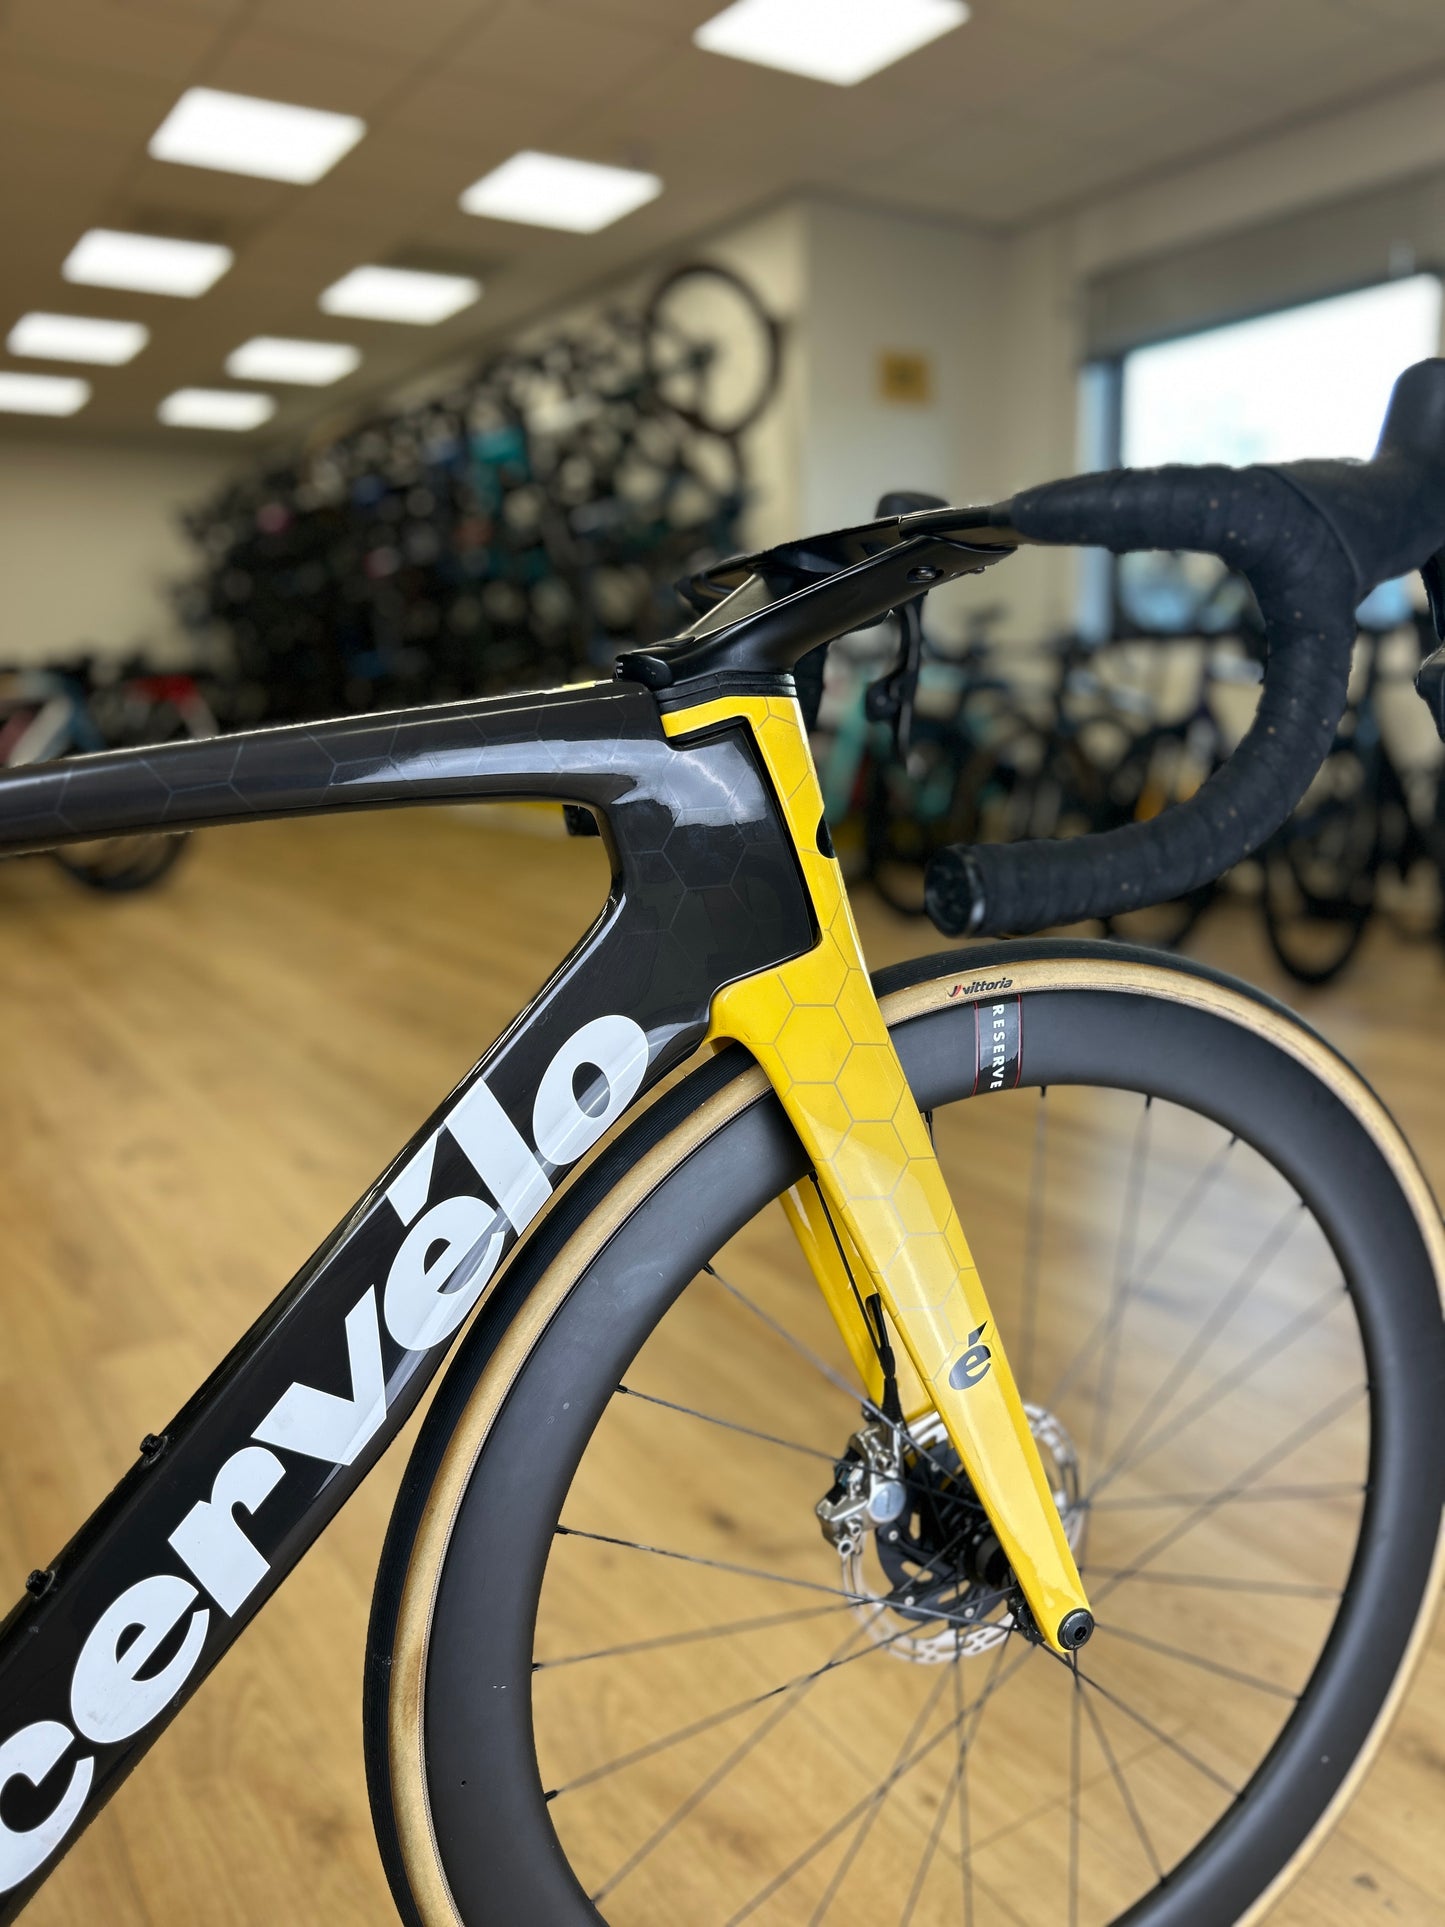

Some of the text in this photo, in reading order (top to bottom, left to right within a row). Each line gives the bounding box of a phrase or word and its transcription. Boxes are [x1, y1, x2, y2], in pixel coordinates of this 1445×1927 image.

[962, 977, 1013, 995] vittoria
[990, 1003, 1005, 1089] RESERVE
[0, 1014, 649, 1894] cervélo
